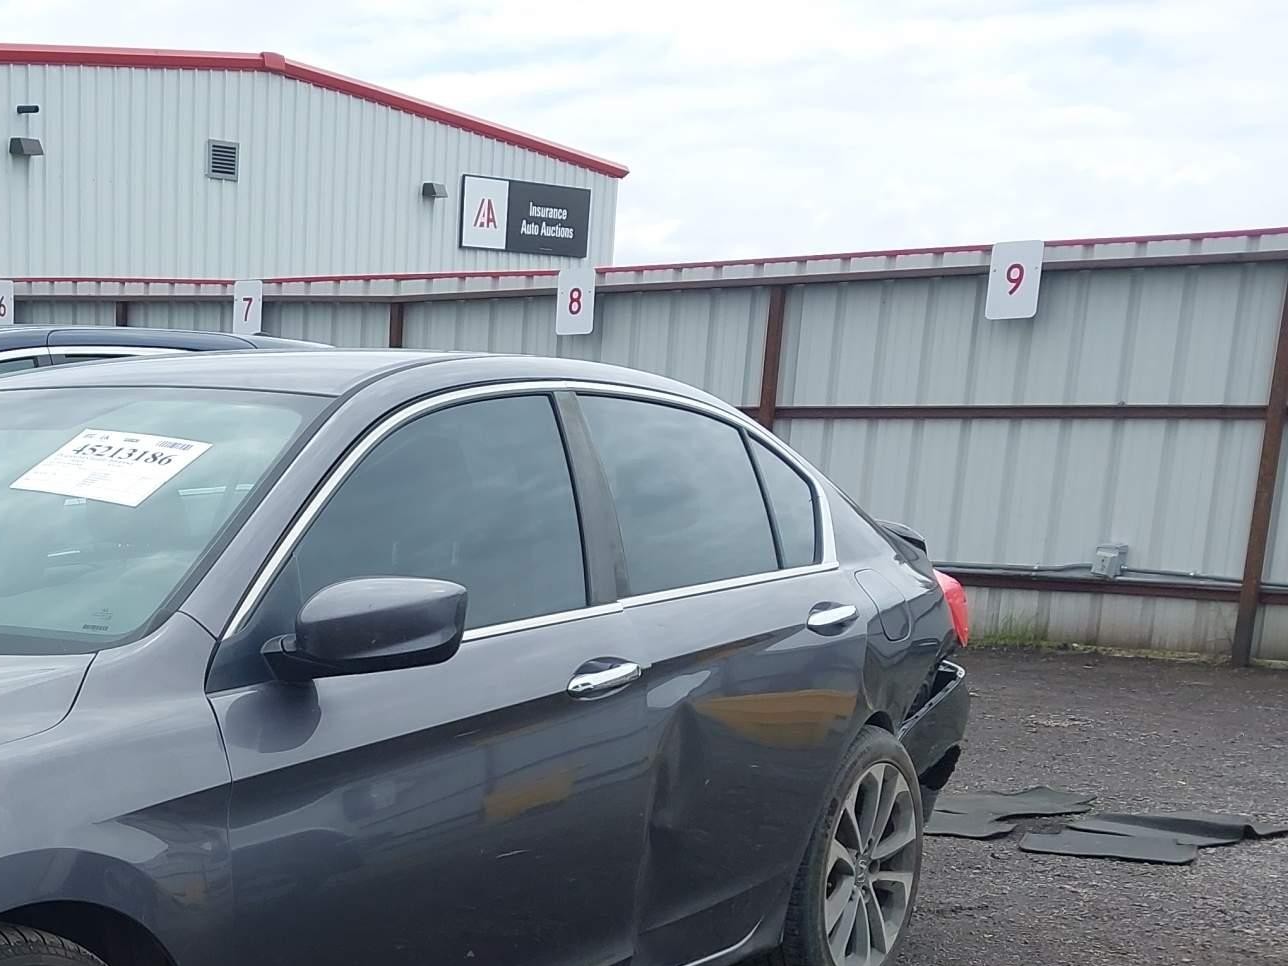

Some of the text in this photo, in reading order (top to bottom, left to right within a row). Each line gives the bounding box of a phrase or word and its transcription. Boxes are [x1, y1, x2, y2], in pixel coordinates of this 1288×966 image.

[529, 201, 568, 220] Insurance
[521, 219, 574, 239] Auto Auctions
[1006, 262, 1025, 295] 9
[242, 298, 253, 322] 7
[568, 287, 583, 315] 8
[72, 443, 178, 466] 45213186
